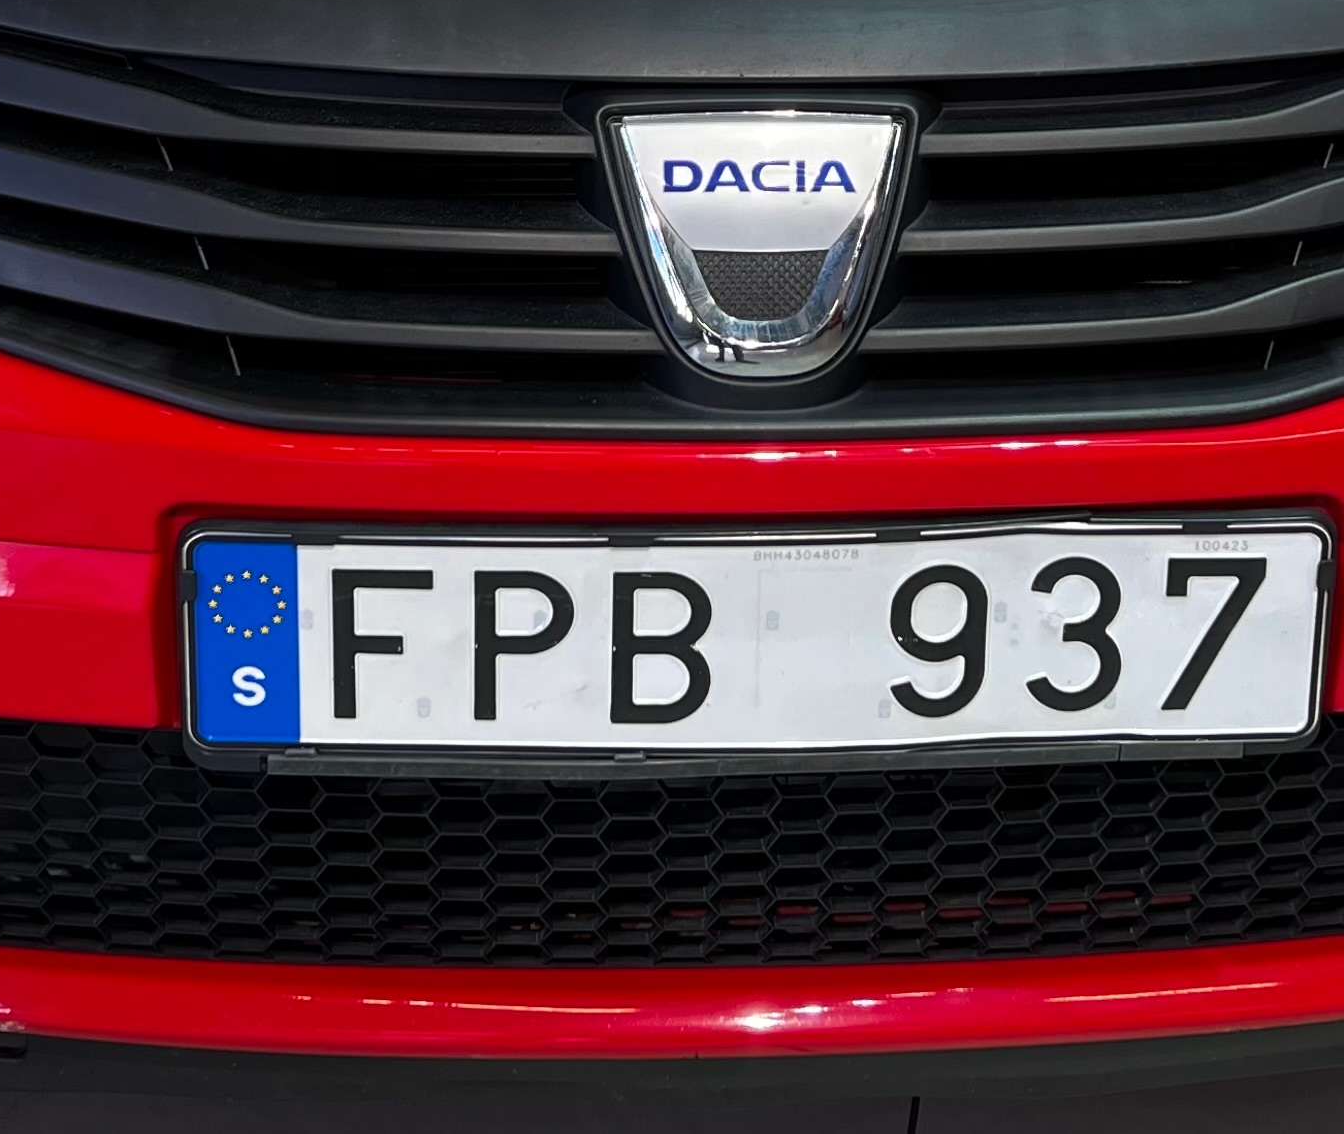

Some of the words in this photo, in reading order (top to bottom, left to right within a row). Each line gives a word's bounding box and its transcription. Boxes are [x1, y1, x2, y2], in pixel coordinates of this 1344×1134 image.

[663, 159, 856, 193] DACIA
[329, 569, 713, 724] FPB
[889, 556, 1268, 718] 937
[232, 666, 266, 707] S
